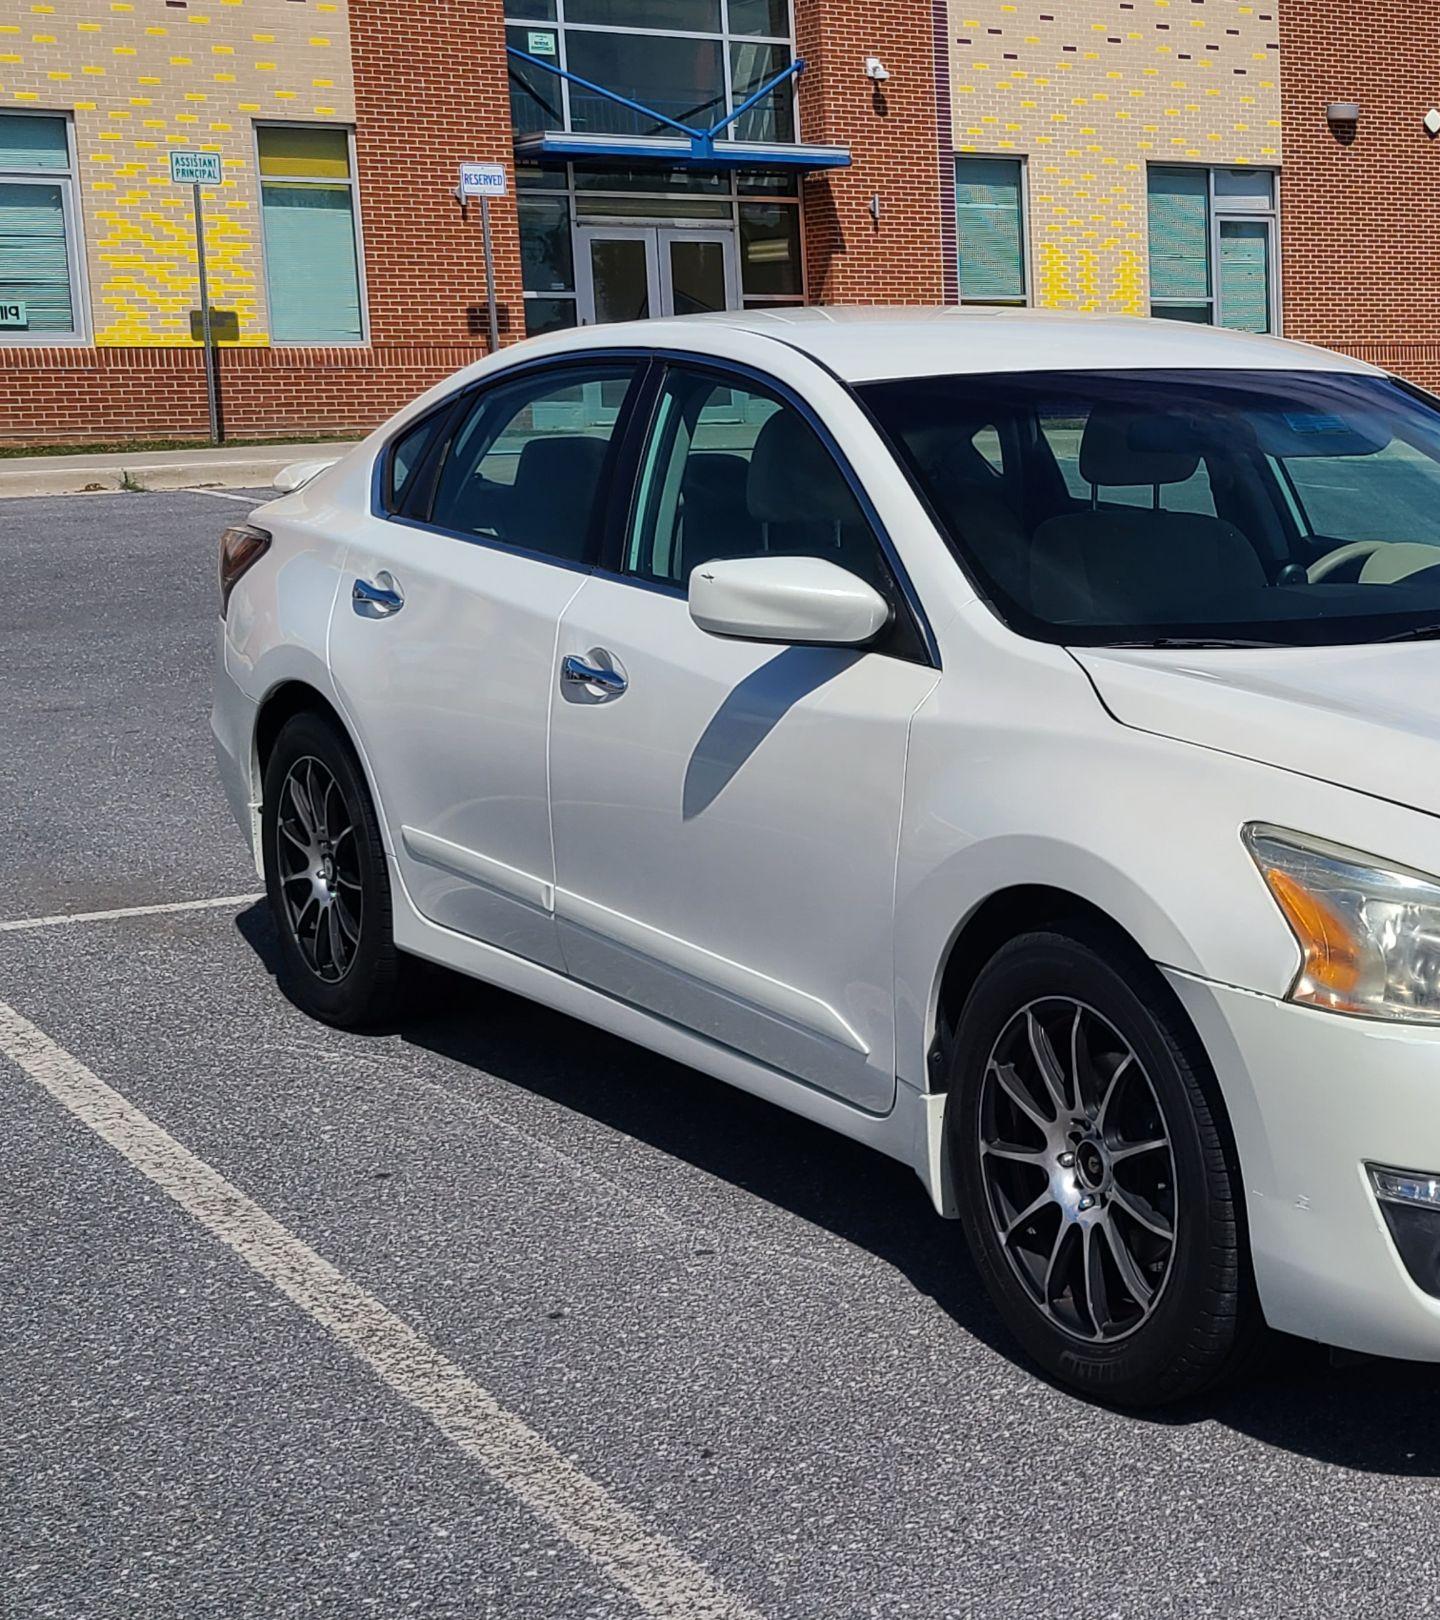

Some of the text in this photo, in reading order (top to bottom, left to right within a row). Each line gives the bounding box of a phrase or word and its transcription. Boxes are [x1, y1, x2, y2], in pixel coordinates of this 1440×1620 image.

[175, 157, 216, 167] ASSISTANT
[176, 168, 217, 179] PRINCIPAL
[464, 173, 503, 185] RESERVED
